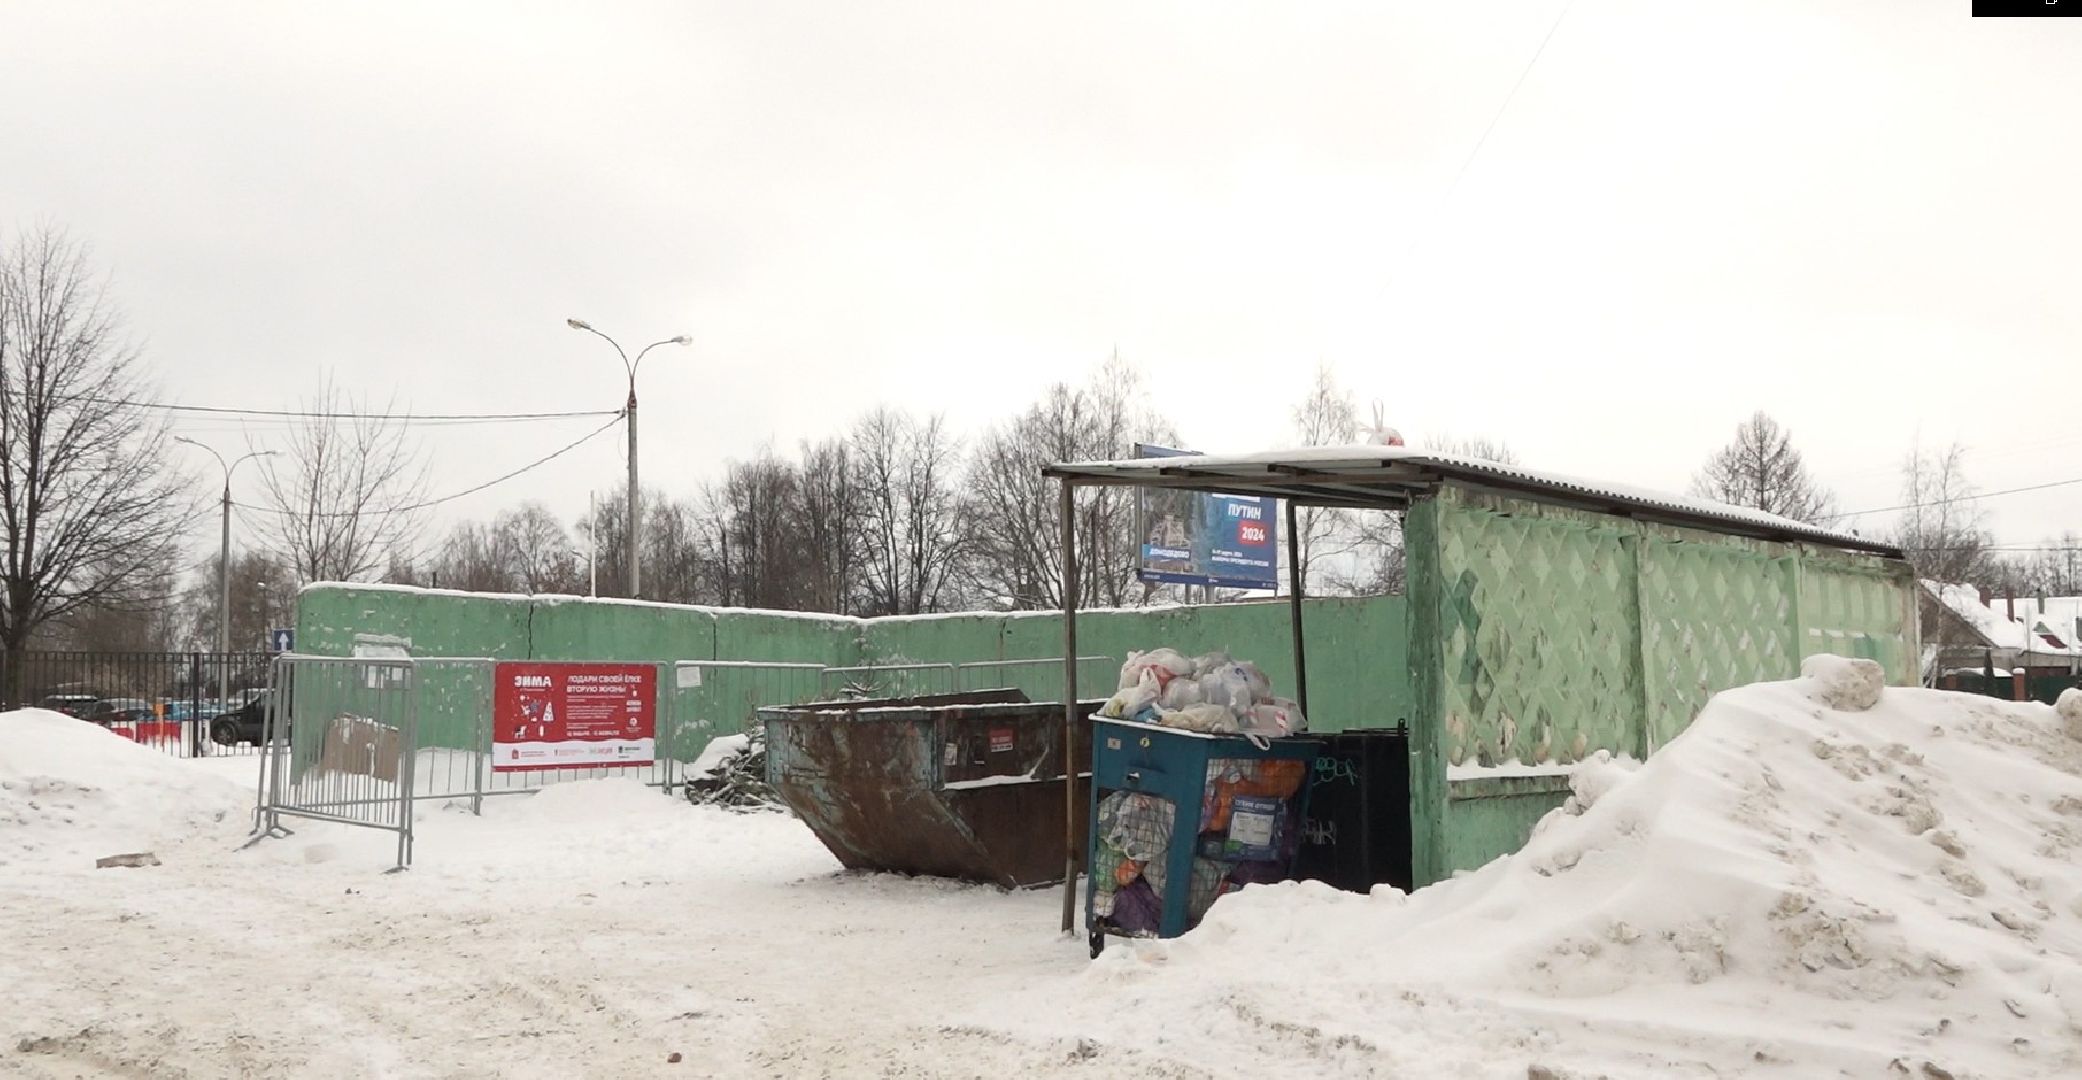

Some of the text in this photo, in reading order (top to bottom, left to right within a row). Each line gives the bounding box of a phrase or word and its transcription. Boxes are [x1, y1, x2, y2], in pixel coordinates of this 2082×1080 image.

[1228, 503, 1262, 520] ПУТИН
[1242, 526, 1265, 541] 2024
[514, 675, 552, 688] ЗИМА
[567, 675, 598, 684] ПОДАРИ
[599, 673, 623, 683] СВОЕЙ
[566, 685, 598, 693] ВТОРУЮ
